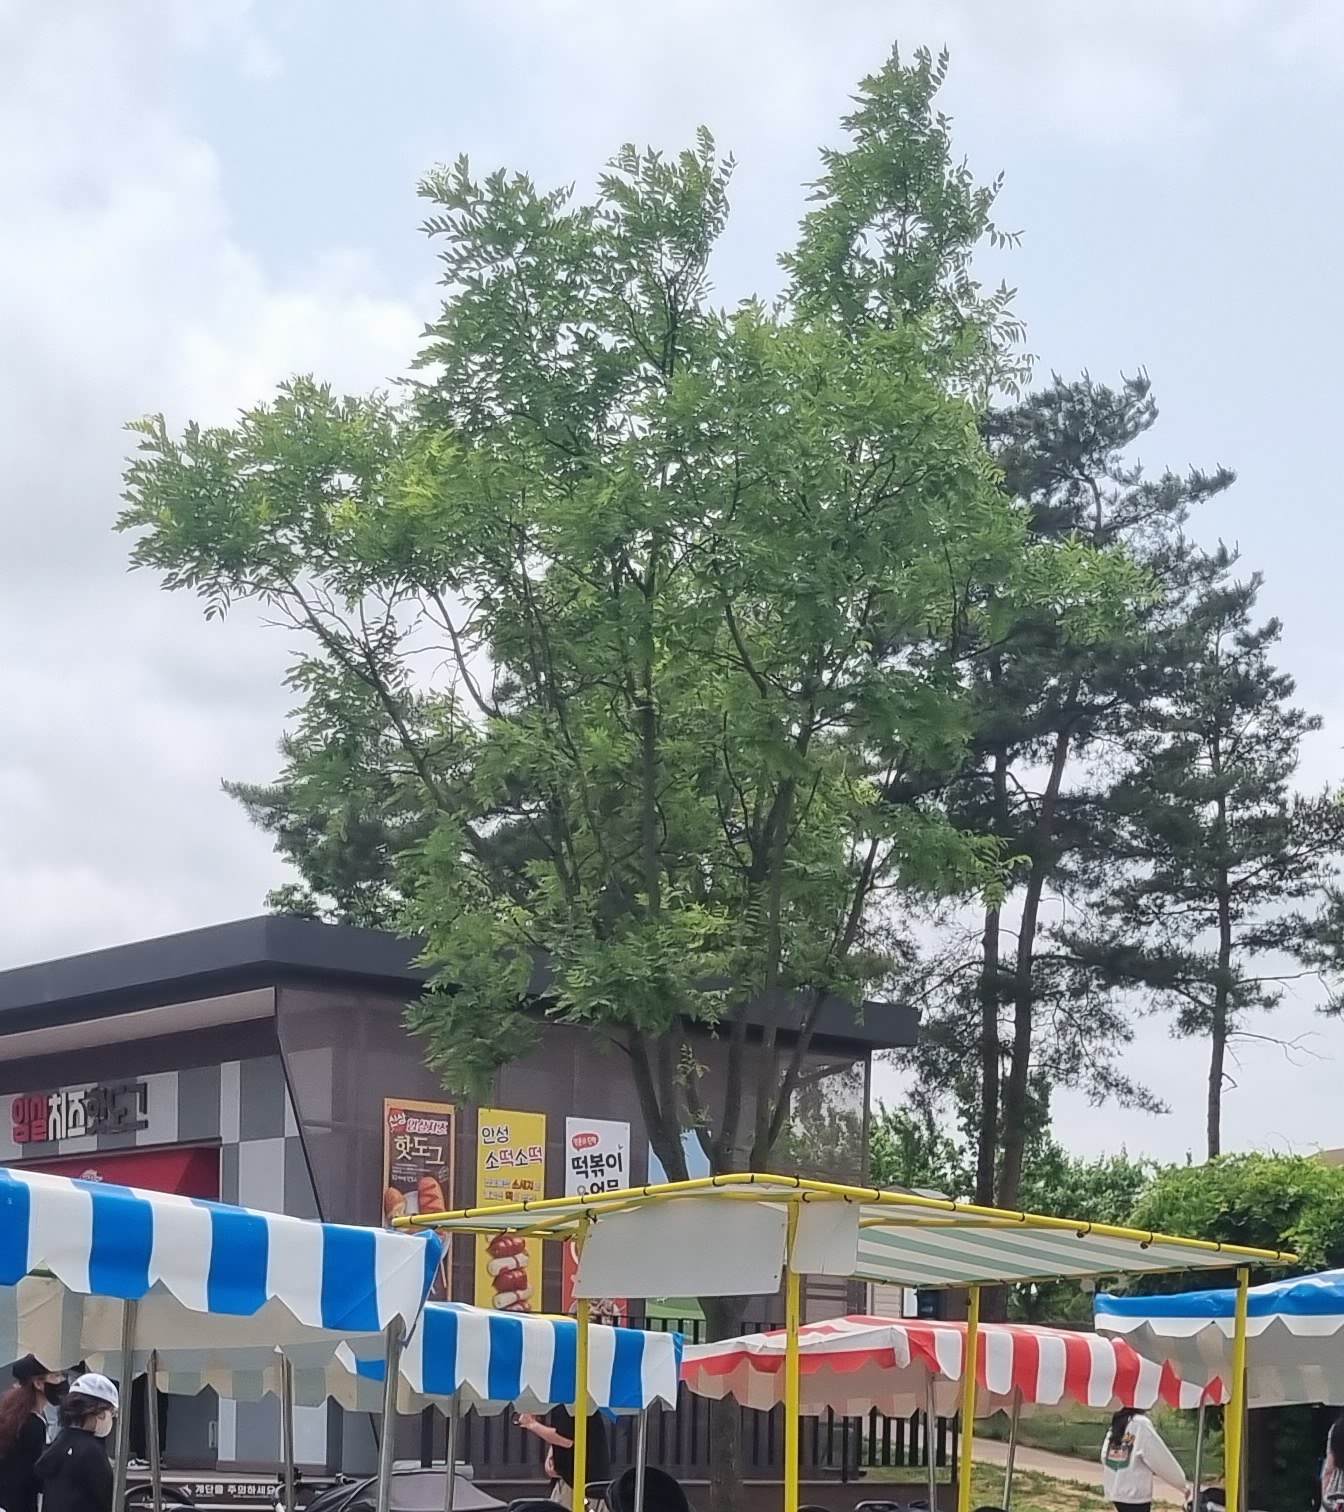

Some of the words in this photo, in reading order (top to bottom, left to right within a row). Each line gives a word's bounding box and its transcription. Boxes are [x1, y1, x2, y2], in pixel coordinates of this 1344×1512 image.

[481, 1125, 510, 1144] 안성
[394, 1134, 445, 1165] 핫도그
[485, 1146, 543, 1170] 소떡소떡
[571, 1153, 622, 1179] 떡볶이
